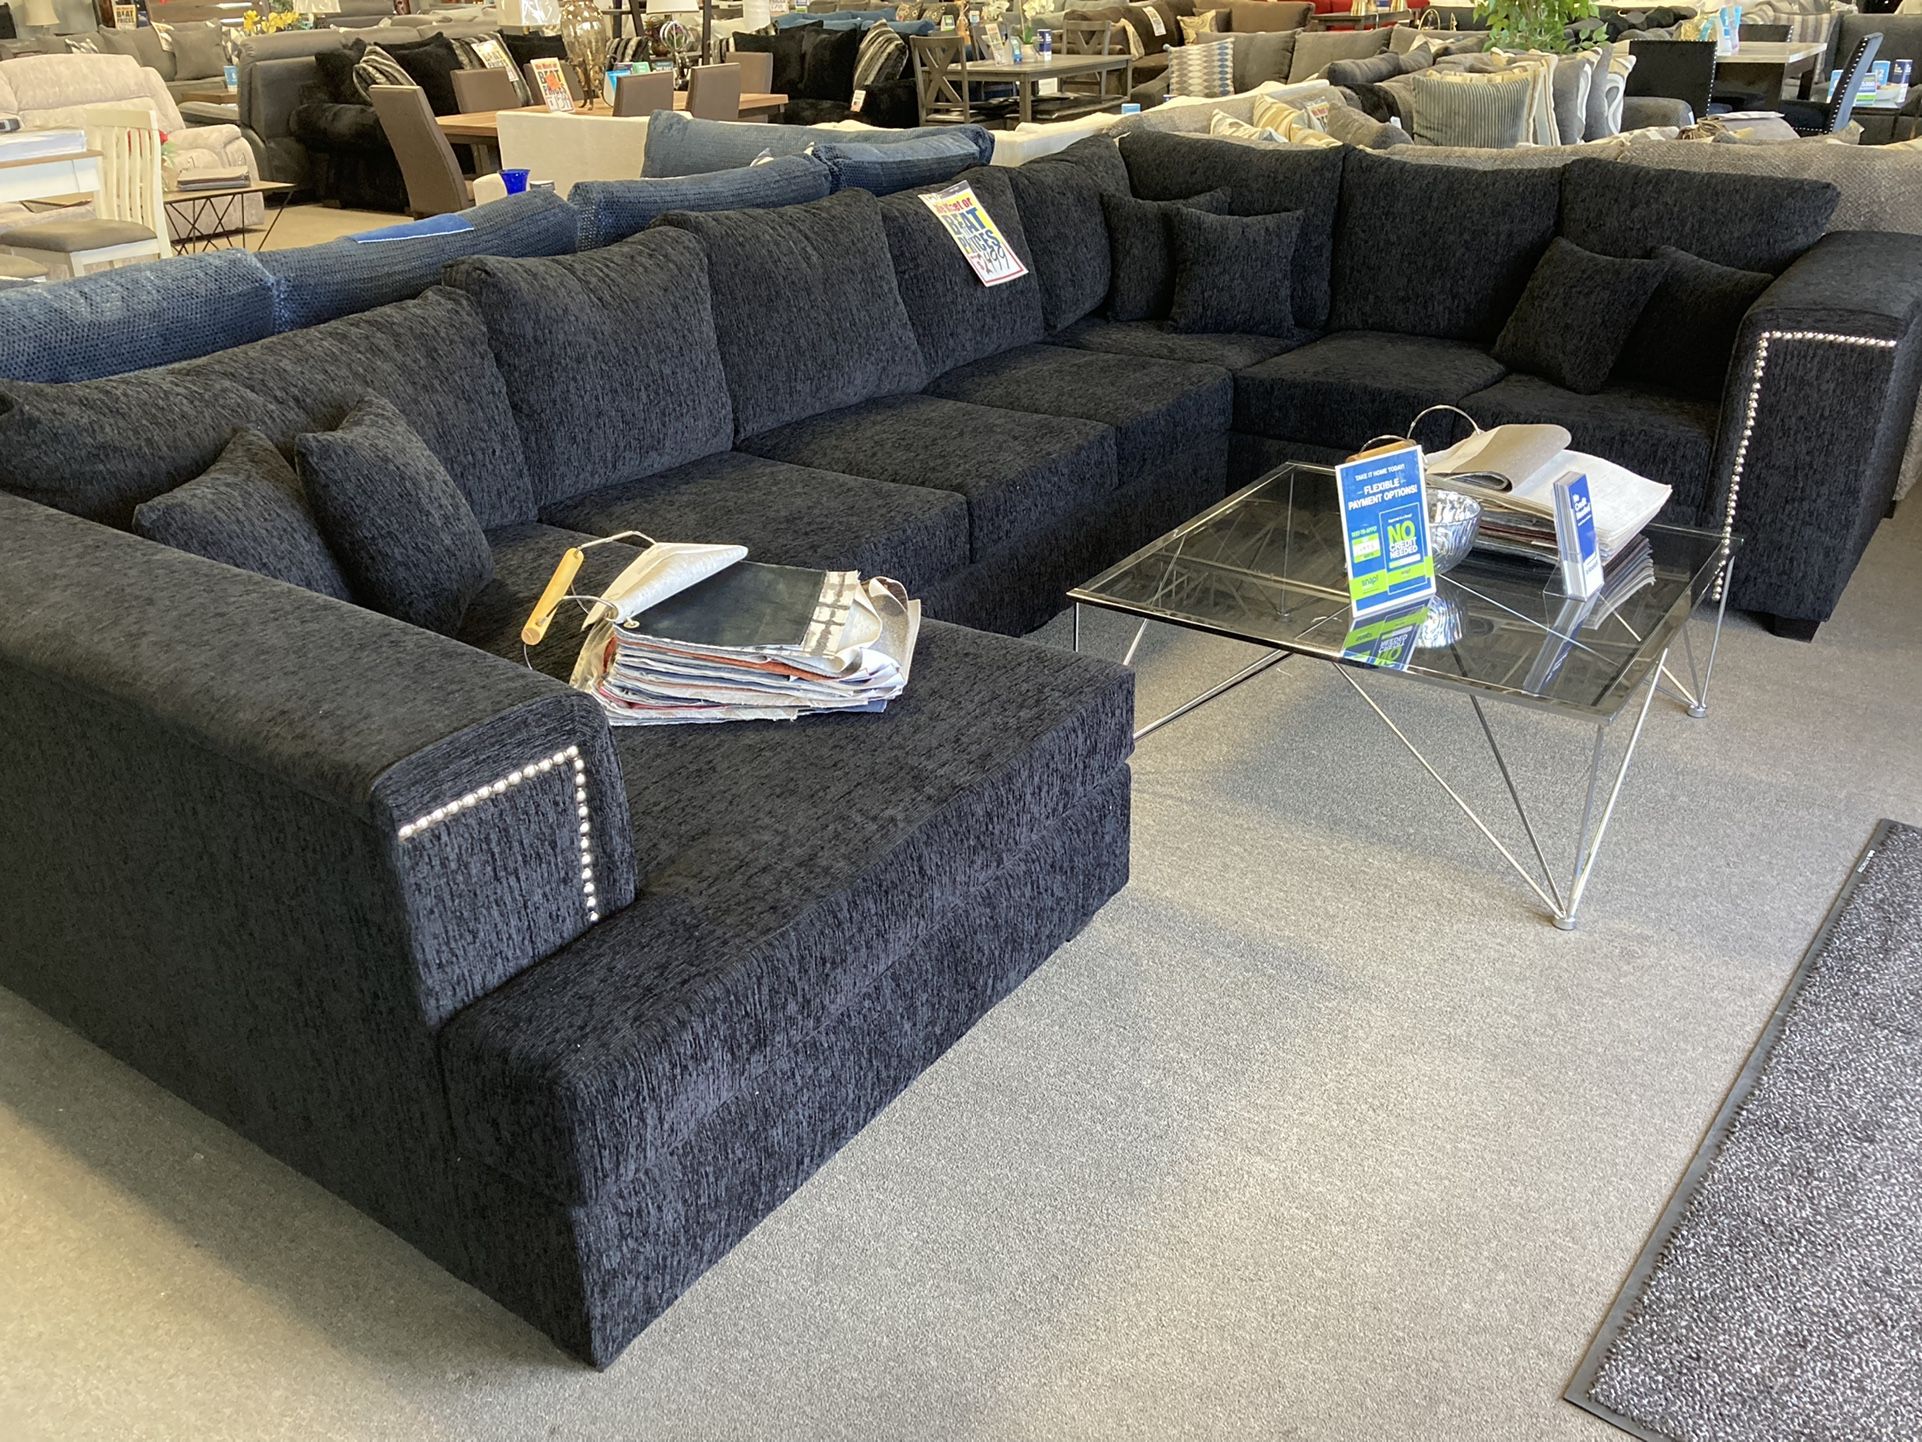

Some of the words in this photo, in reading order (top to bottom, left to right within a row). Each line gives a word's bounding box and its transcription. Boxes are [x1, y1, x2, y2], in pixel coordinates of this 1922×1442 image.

[941, 207, 986, 236] BEAT
[957, 229, 1001, 255] PRICES
[1355, 472, 1368, 481] TAKE
[1367, 471, 1373, 479] IT
[1373, 468, 1388, 477] HOME
[1387, 463, 1406, 473] TODAY!
[1363, 478, 1400, 495] FLEXIBLE
[1348, 493, 1383, 510] PAYMENT
[1383, 484, 1418, 501] OPTIONS!
[1387, 520, 1416, 543] NO
[1389, 537, 1417, 552] CREDIT
[1389, 545, 1419, 560] NEEDED
